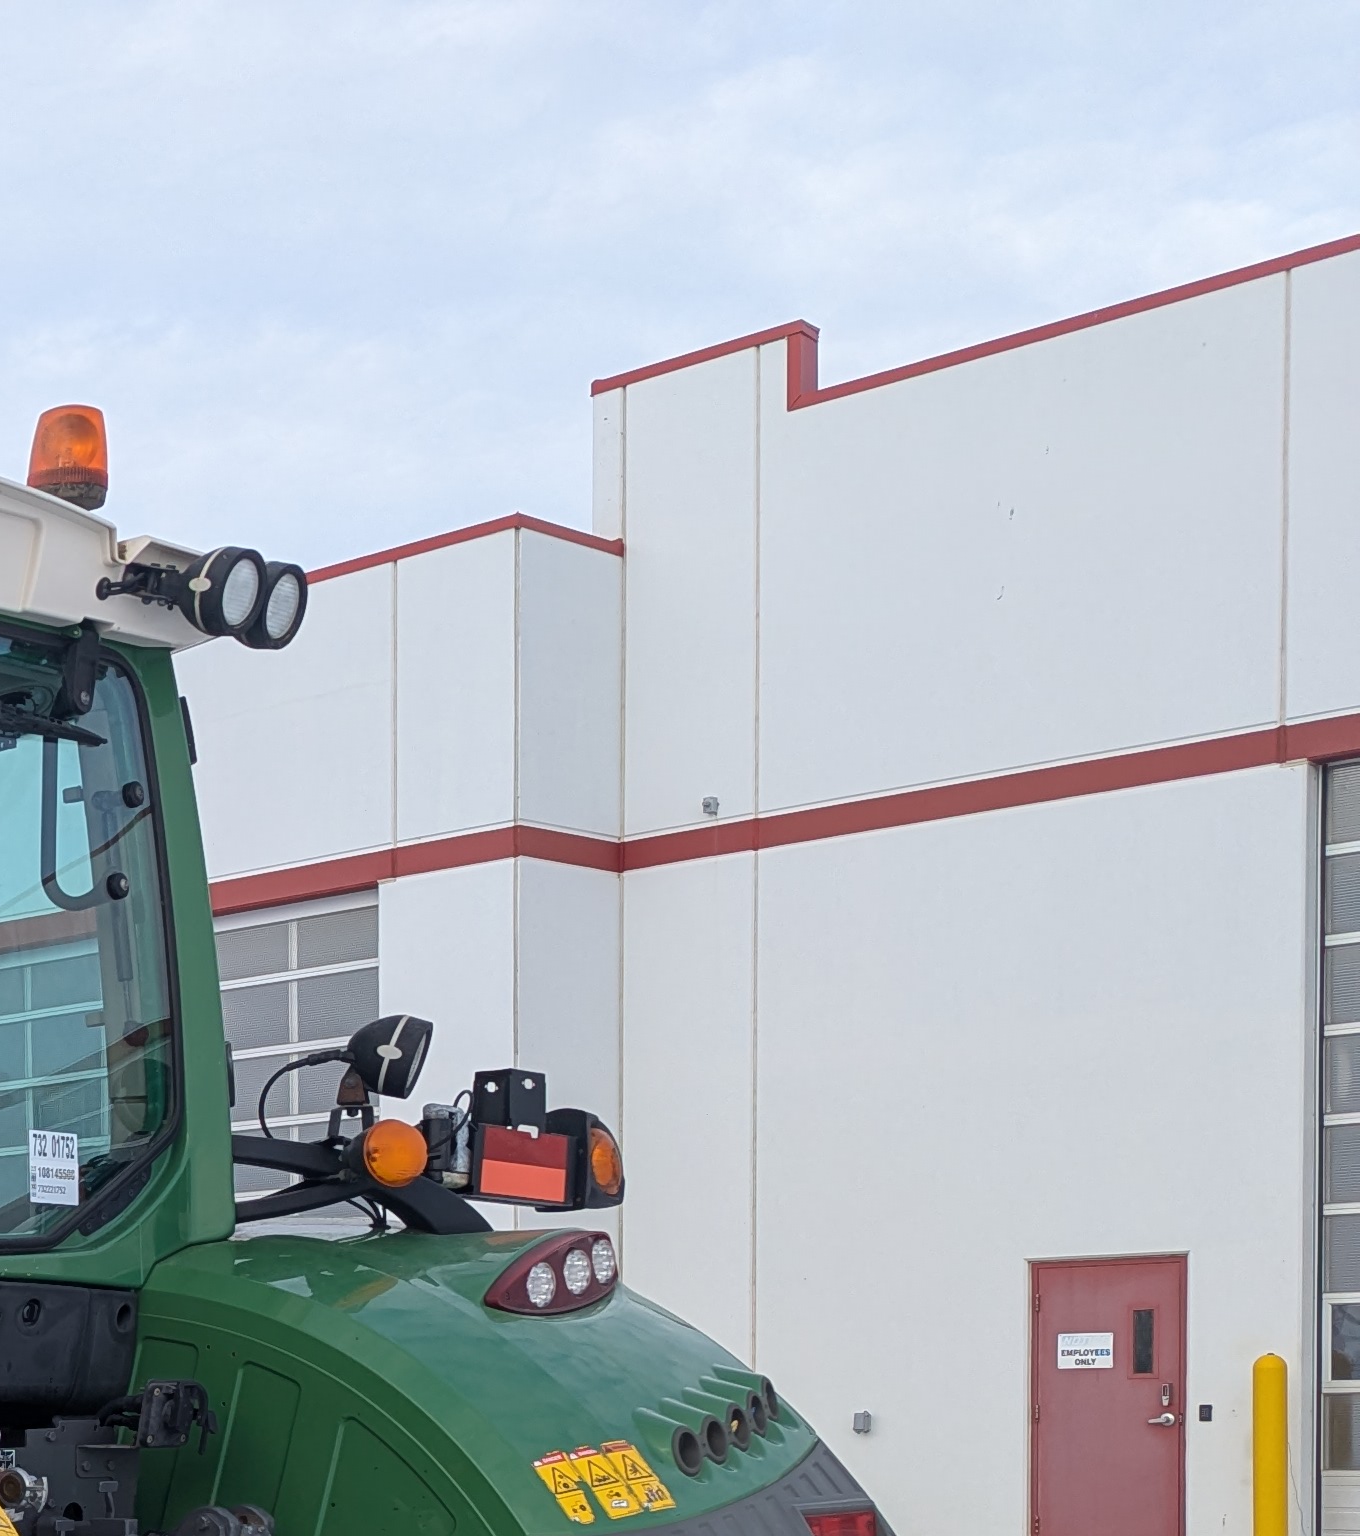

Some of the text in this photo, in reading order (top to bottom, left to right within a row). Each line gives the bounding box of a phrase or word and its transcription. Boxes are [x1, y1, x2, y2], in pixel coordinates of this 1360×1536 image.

[32, 1133, 75, 1159] 732 01752
[1061, 1348, 1111, 1357] EMPLOYEES
[1074, 1358, 1097, 1366] ONLY
